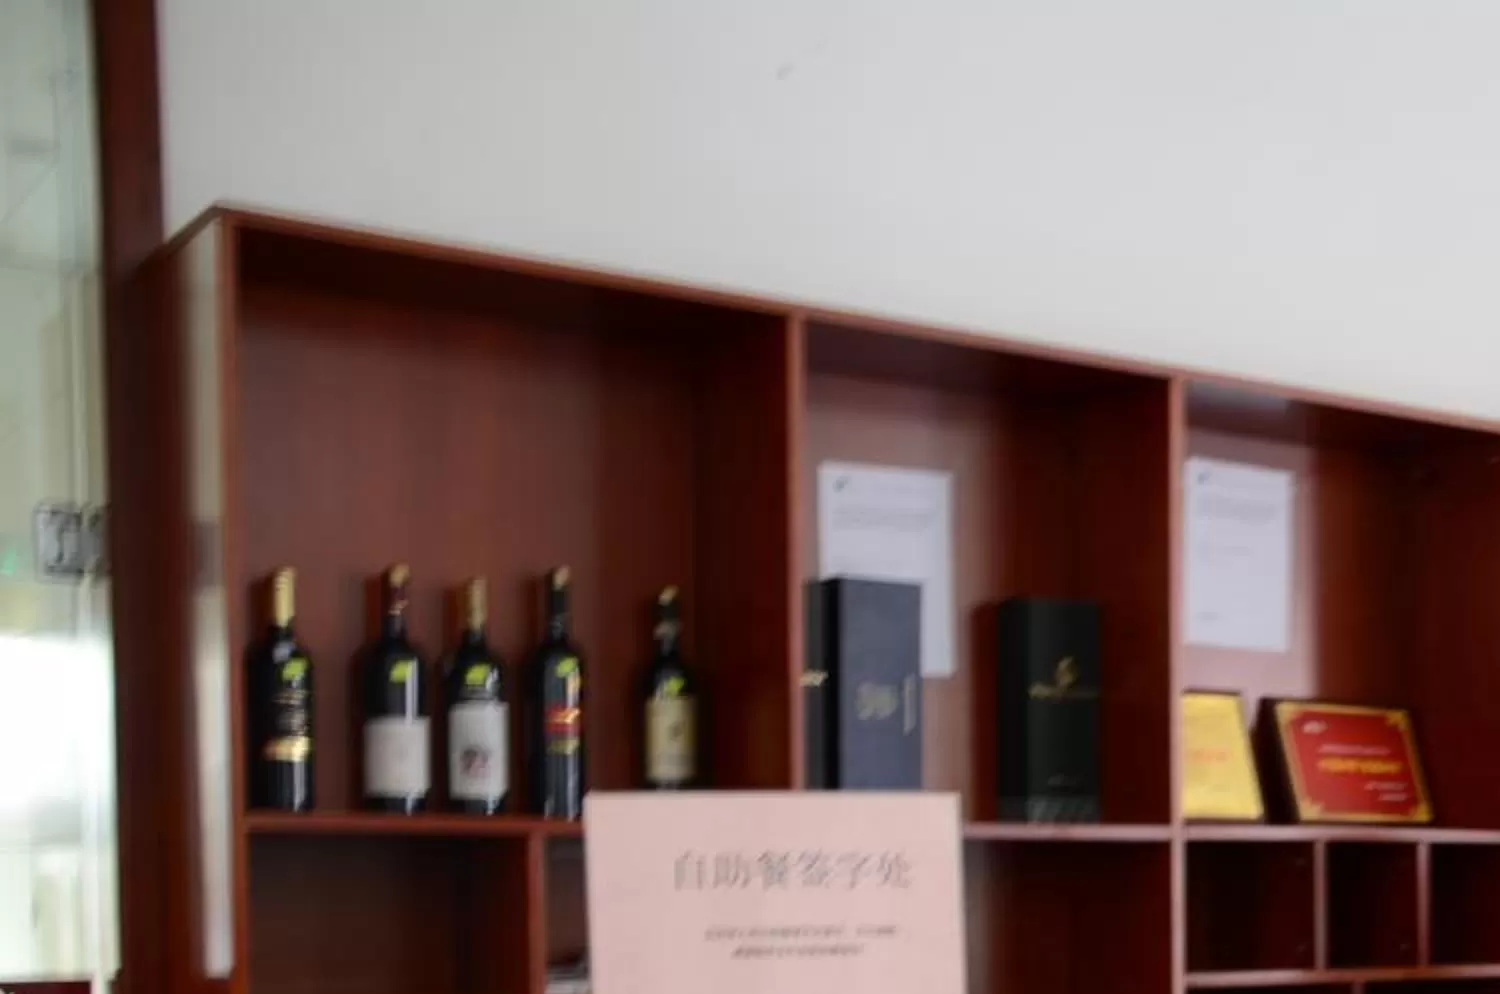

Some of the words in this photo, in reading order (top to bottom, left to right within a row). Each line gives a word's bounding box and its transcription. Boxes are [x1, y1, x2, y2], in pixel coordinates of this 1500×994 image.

[674, 848, 912, 891] 自助餐签字处
